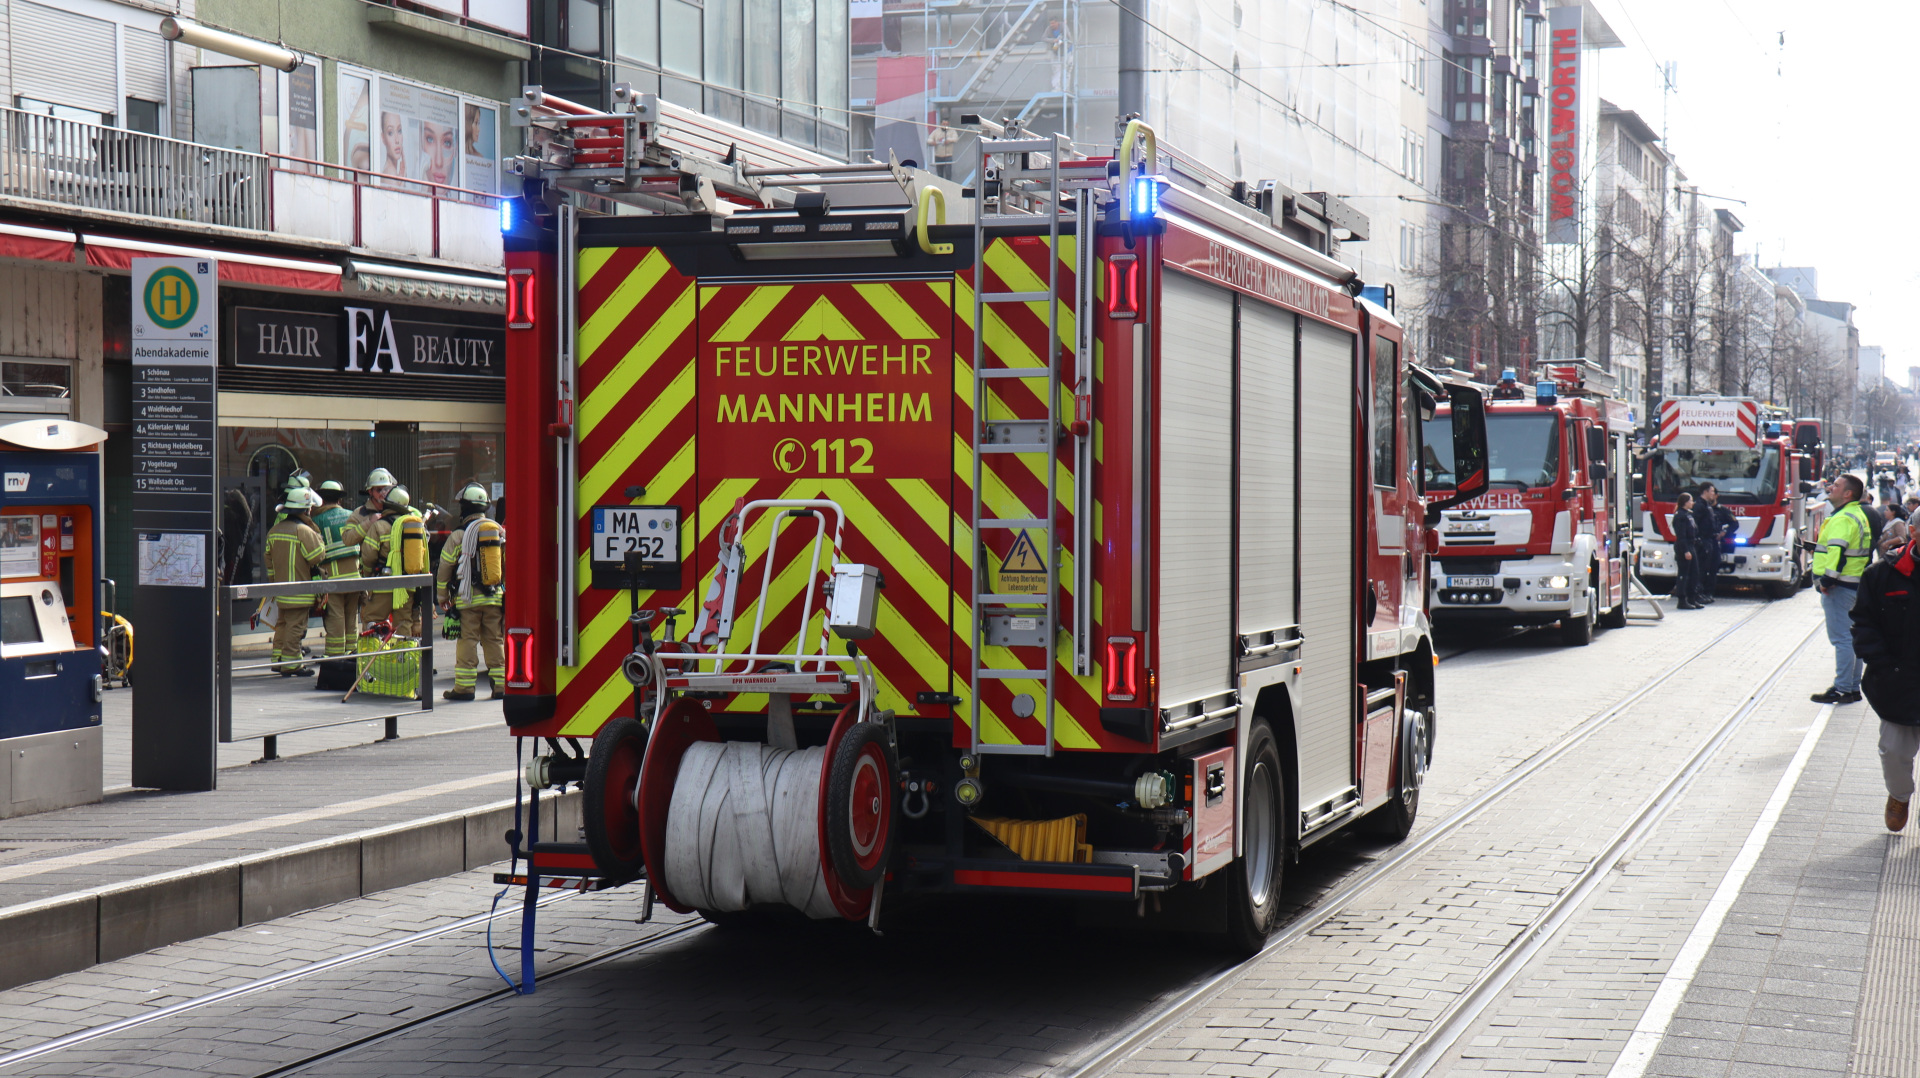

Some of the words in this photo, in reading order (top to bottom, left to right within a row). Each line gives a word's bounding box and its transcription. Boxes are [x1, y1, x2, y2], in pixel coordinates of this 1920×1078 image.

[1550, 29, 1577, 221] WOOLWORTH
[1209, 241, 1262, 293] FEUERWEHR
[1265, 266, 1310, 311] MANNHEIM
[1318, 288, 1329, 318] 112
[160, 281, 182, 315] H
[257, 323, 322, 357] HAIR
[344, 306, 404, 373] FA
[412, 334, 494, 367] BEAUTY
[134, 347, 209, 358] Abendakademie
[716, 344, 932, 377] FEUERWEHR
[141, 370, 145, 380] 1
[147, 368, 170, 376] Schönau
[141, 388, 146, 397] 3
[141, 407, 146, 416] 4
[147, 405, 183, 413] Waldfriedhof
[716, 392, 933, 423] MANNHEIM
[1681, 409, 1735, 418] FEUERWEHR
[147, 423, 174, 431] Käfertaler
[1681, 420, 1735, 428] MANNHEIM
[141, 443, 147, 453] 5
[147, 442, 171, 450] Richtung
[172, 443, 203, 451] Heidelberg
[810, 437, 875, 474] 112
[141, 461, 146, 471] 7
[147, 460, 178, 469] Vogelstang
[8, 477, 25, 486] rnv
[136, 479, 147, 489] 15
[613, 512, 640, 534] MA
[606, 536, 620, 558] F
[625, 536, 664, 558] 252
[1001, 574, 1020, 583] Achtung
[1453, 578, 1464, 586] MA
[1475, 578, 1490, 586] 178
[1008, 583, 1038, 592] Lebensgefahr
